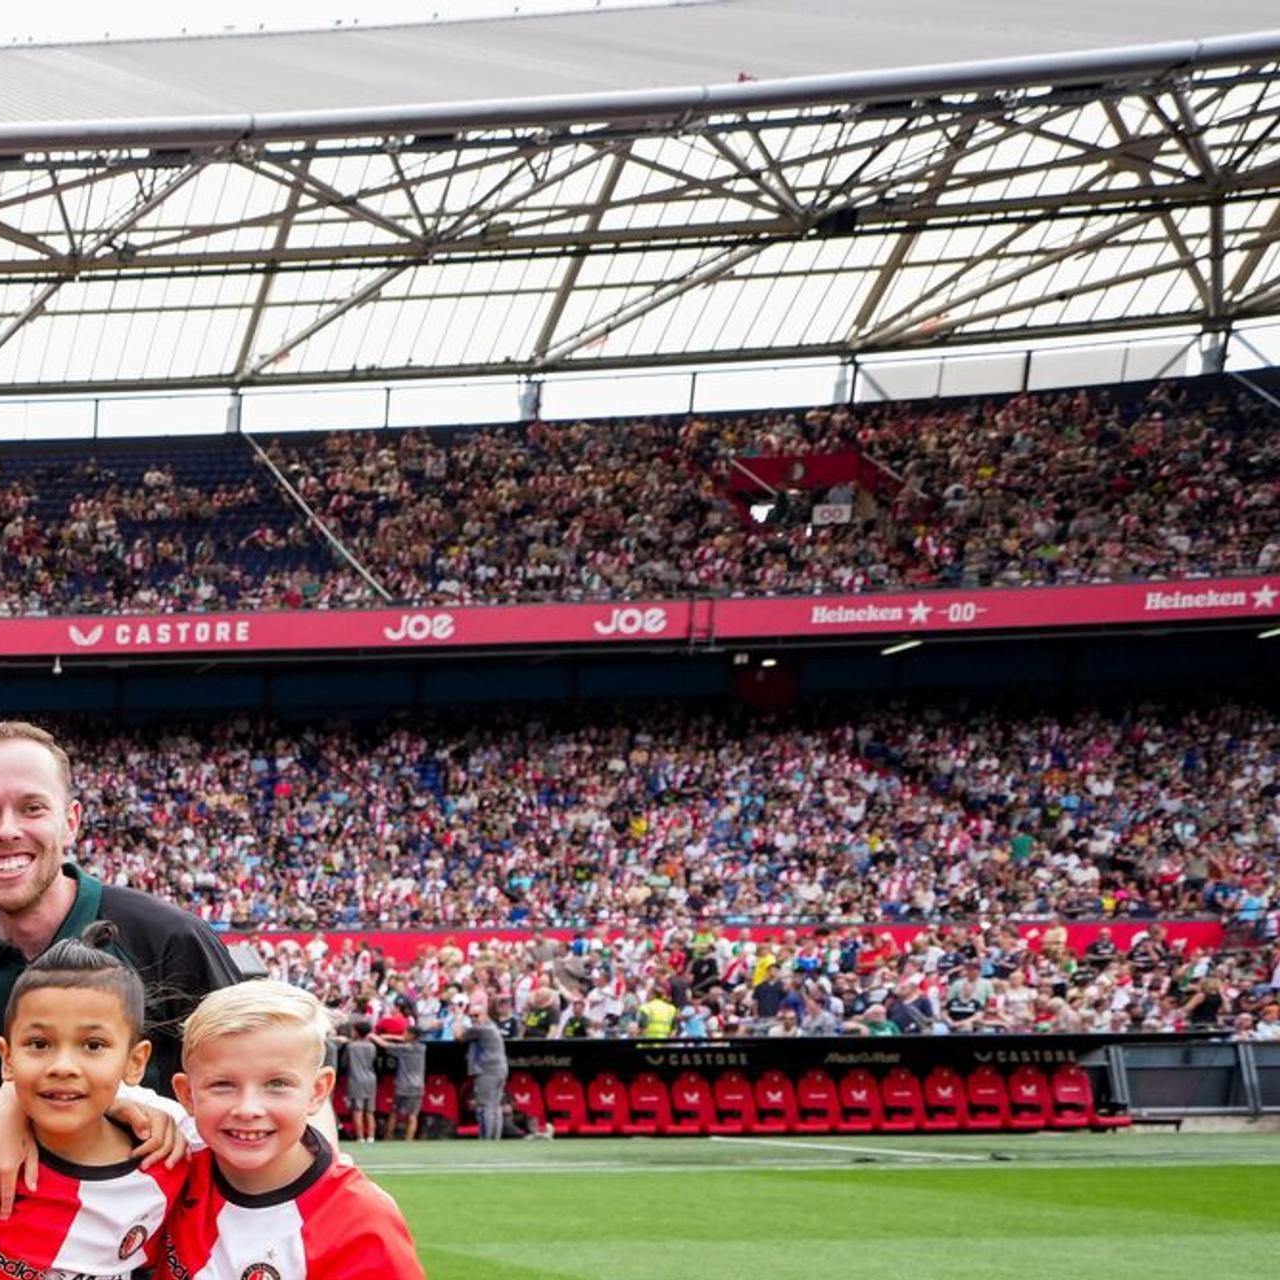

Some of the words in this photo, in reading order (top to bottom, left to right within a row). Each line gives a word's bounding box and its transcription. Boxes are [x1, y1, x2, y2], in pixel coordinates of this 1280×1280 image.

[1145, 590, 1246, 610] Heineken
[811, 604, 903, 624] Heineken
[115, 622, 250, 645] CASTORE
